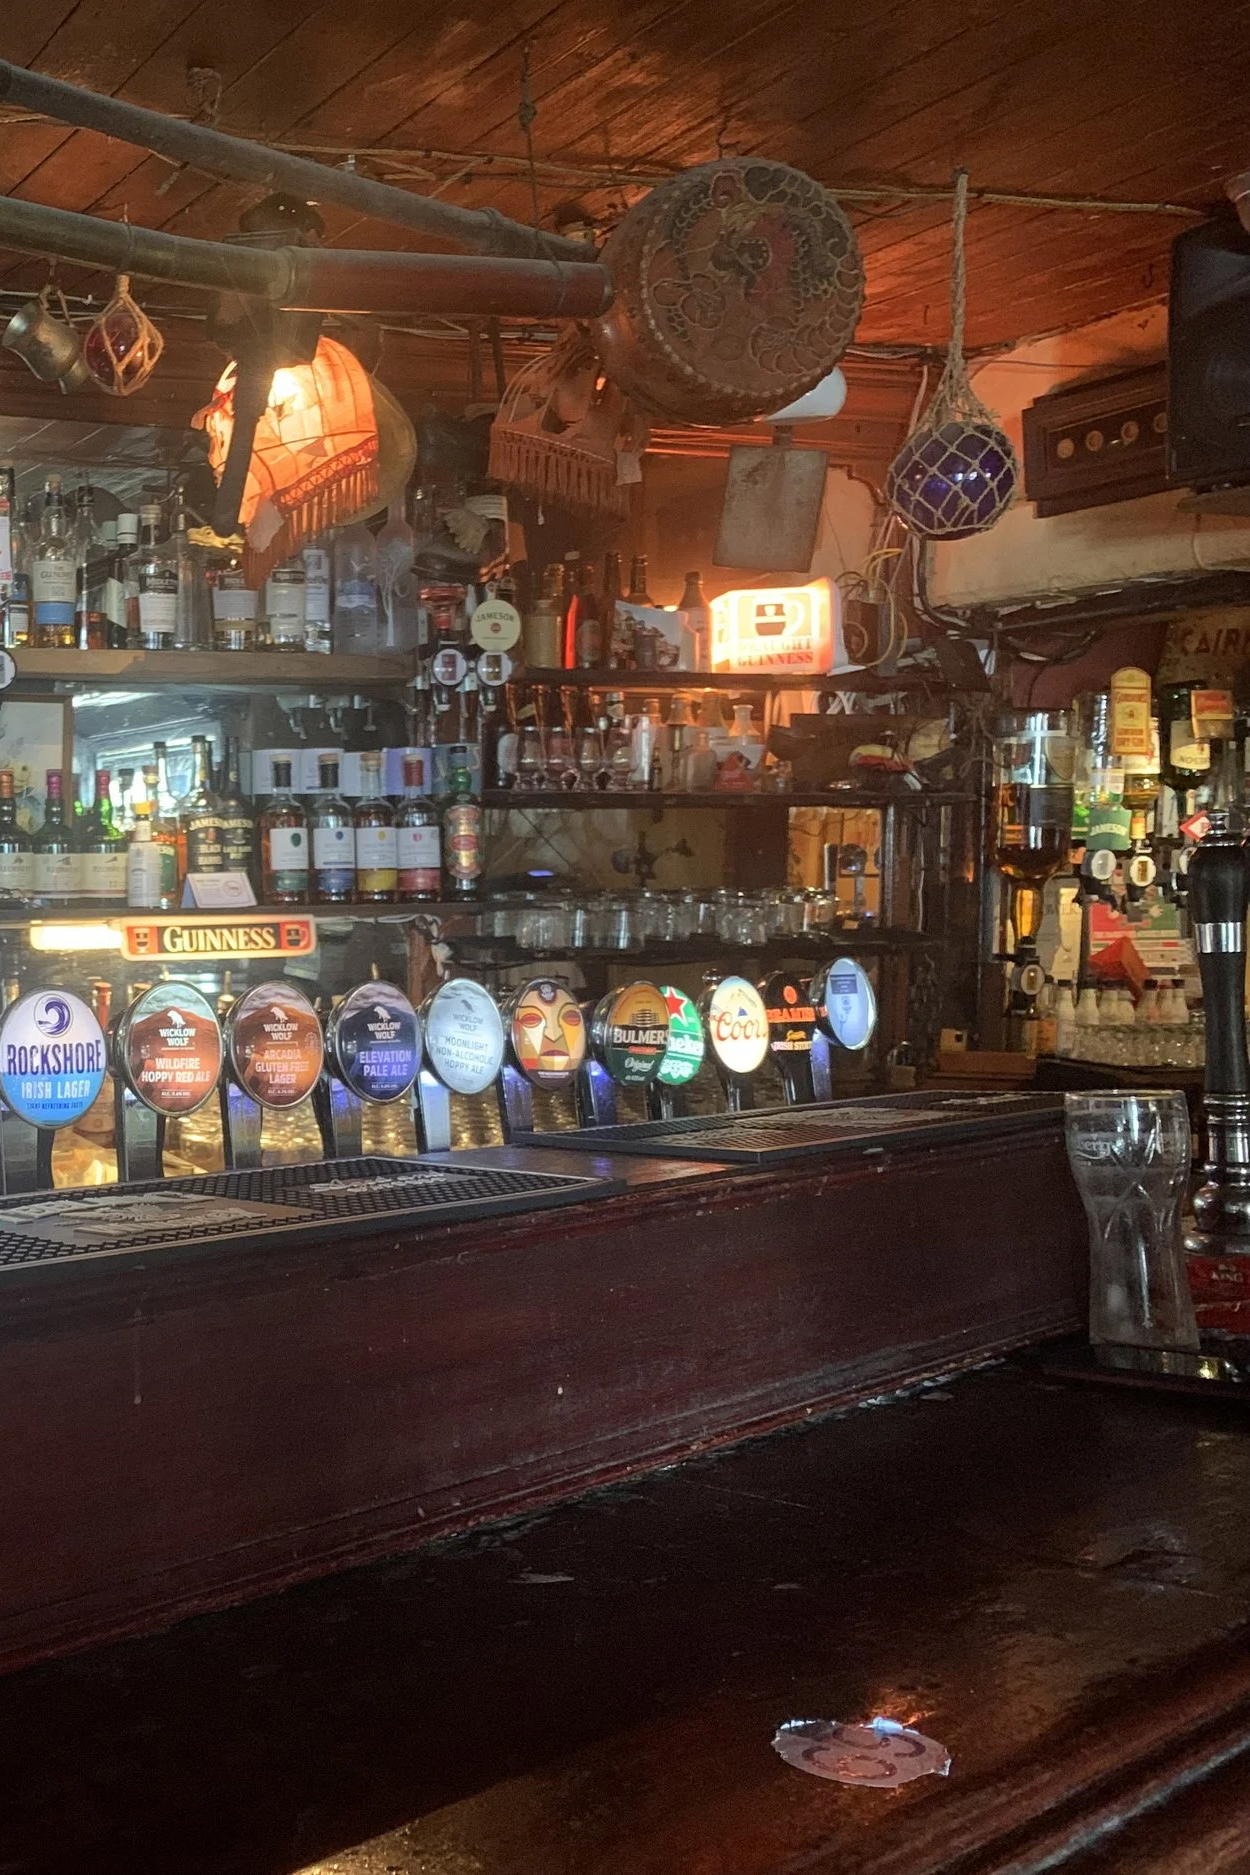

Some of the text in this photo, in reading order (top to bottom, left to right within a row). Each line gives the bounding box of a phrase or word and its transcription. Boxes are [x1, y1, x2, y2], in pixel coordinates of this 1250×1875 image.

[475, 612, 516, 623] JAMESON
[738, 651, 814, 667] GUINNESS
[163, 926, 276, 953] GUINNESS
[452, 1014, 484, 1025] WICKLOW
[263, 1023, 299, 1032] WICKLOW
[367, 1022, 402, 1032] WICKLOW
[458, 1023, 478, 1032] WOLF
[159, 1028, 196, 1038] WICKLOW
[270, 1031, 293, 1041] WOLF
[375, 1031, 396, 1040] WOLF
[166, 1037, 189, 1047] WOLF
[445, 1036, 489, 1052] MOONLIGHT
[7, 1039, 102, 1077] ROCKSHORE
[263, 1049, 302, 1060] ARCADIA
[359, 1051, 412, 1064] ELEVATION
[435, 1047, 495, 1065] NON-ALCOHOLIC
[155, 1057, 201, 1070] WILDFIRE
[255, 1061, 310, 1072] GLUTEN FREE
[443, 1060, 485, 1075] HOPPY ALE
[363, 1064, 408, 1077] PALE ALE
[141, 1070, 211, 1083] HOPPY RED ALE
[268, 1074, 297, 1085] LAGER
[21, 1080, 91, 1099] IRISH LAGER
